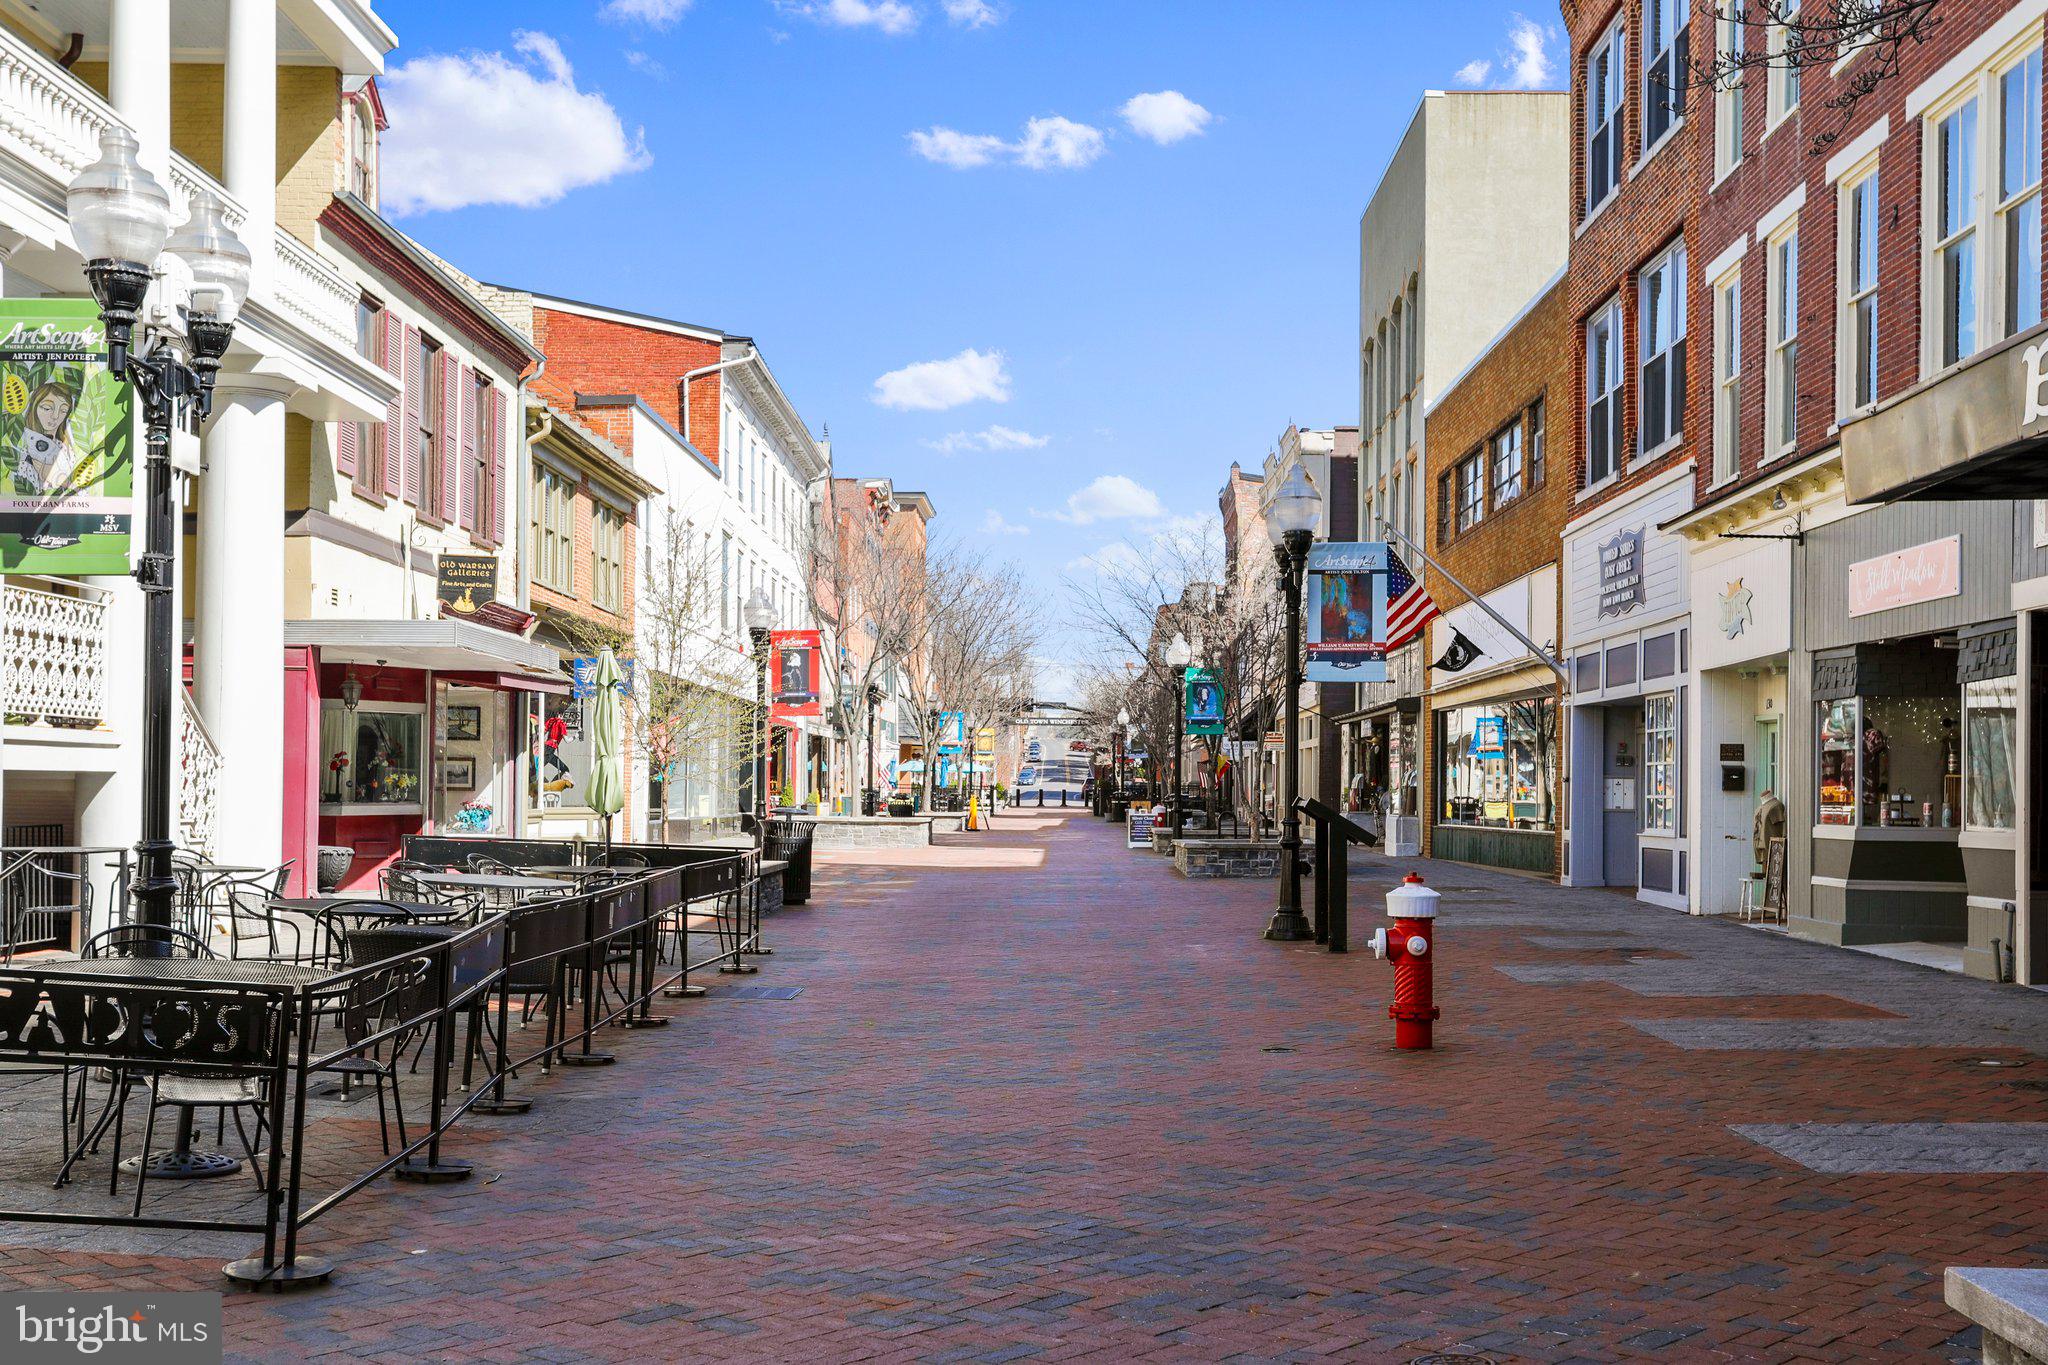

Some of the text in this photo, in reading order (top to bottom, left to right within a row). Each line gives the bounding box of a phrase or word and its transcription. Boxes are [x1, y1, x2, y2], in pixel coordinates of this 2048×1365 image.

[46, 353, 62, 361] JEN
[64, 353, 97, 361] POTEET
[100, 524, 120, 532] MSV
